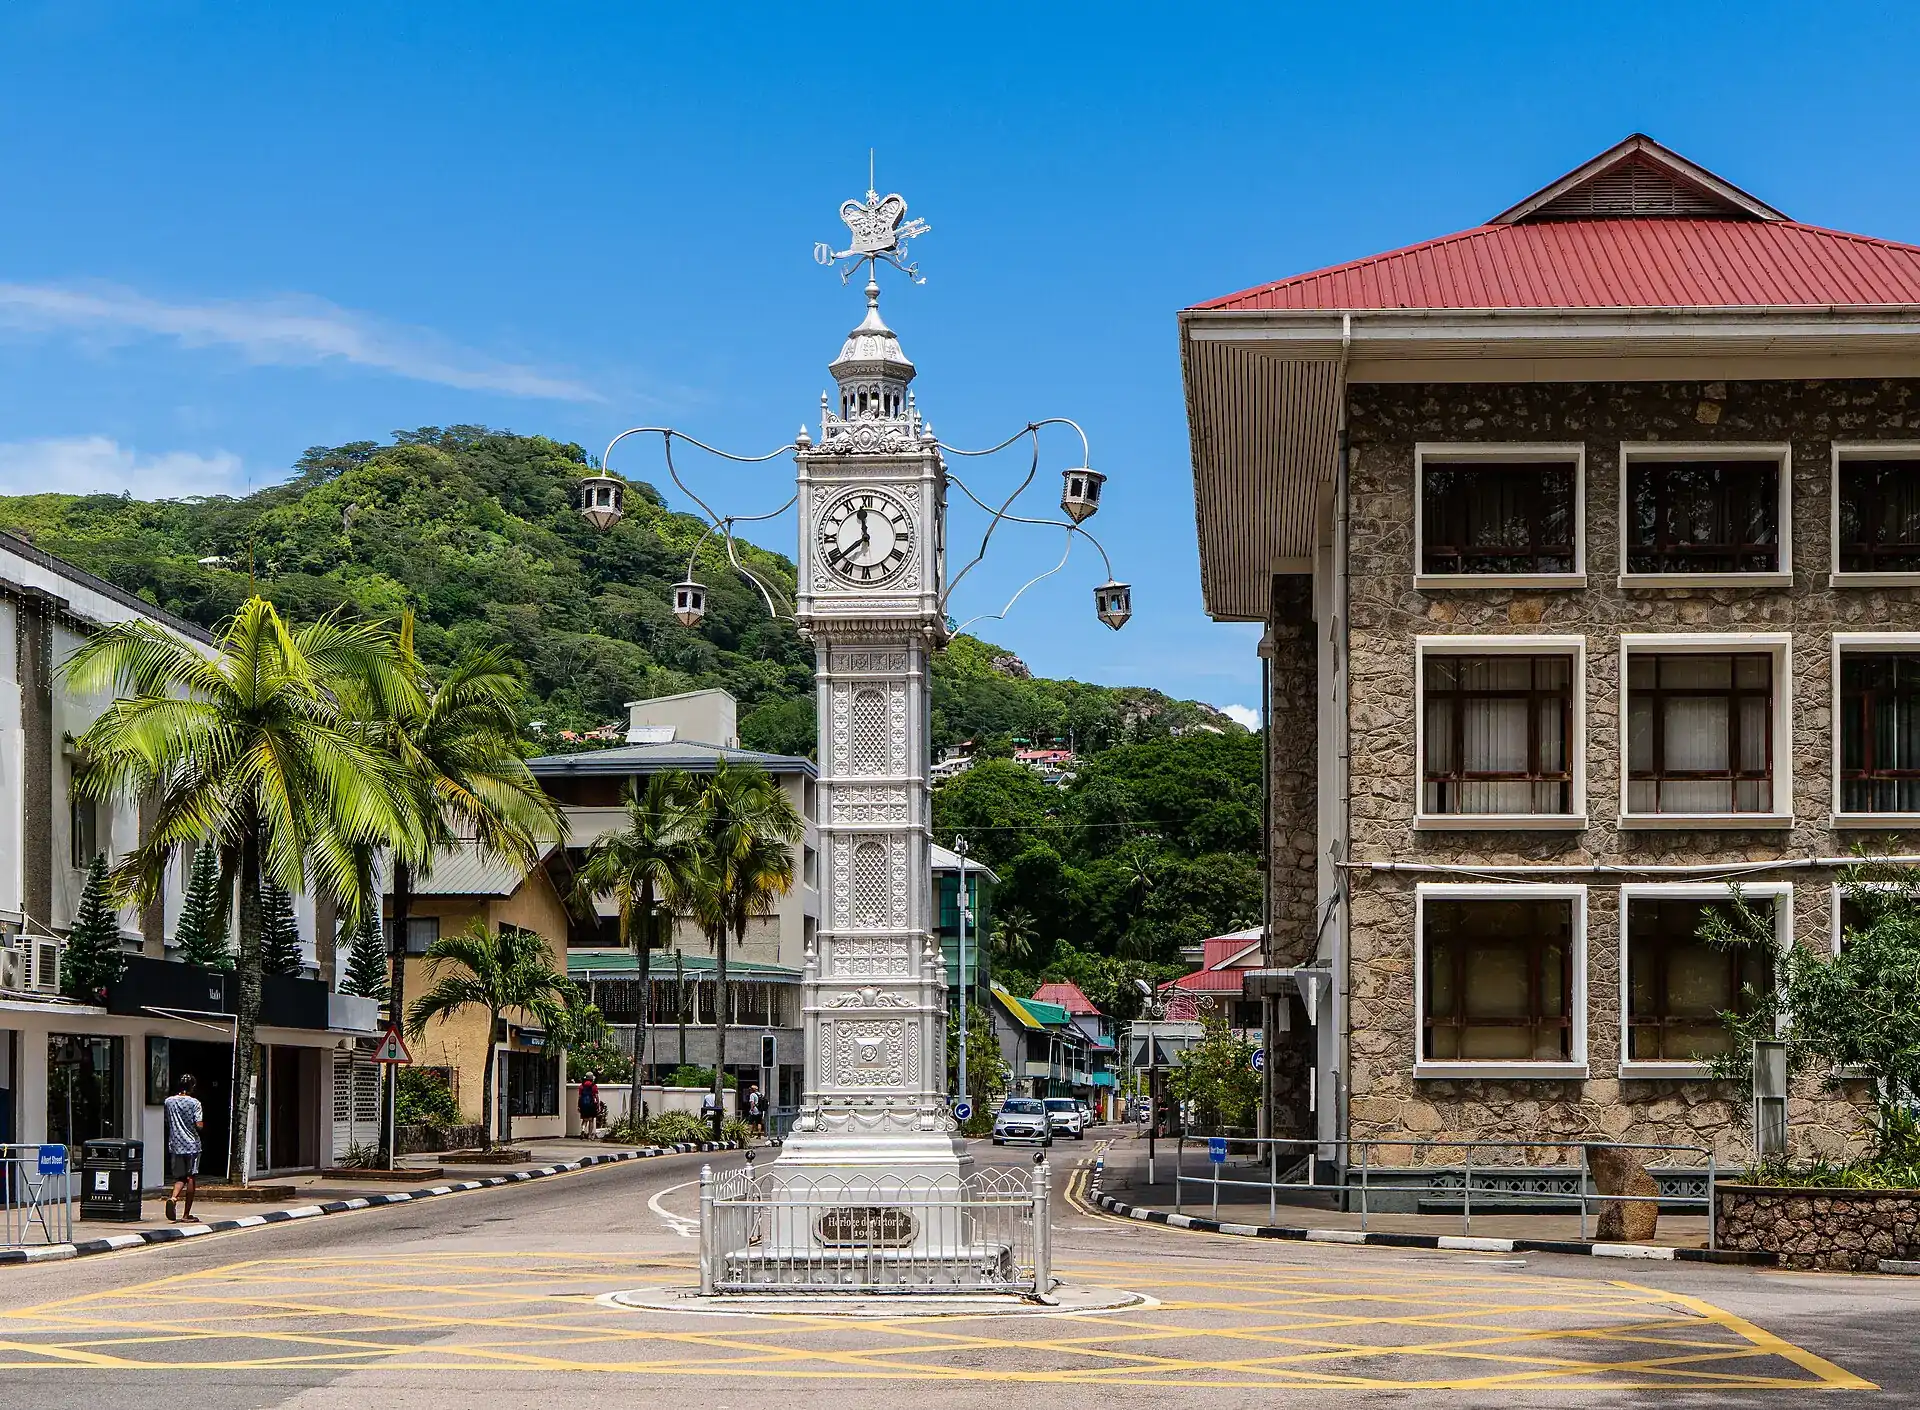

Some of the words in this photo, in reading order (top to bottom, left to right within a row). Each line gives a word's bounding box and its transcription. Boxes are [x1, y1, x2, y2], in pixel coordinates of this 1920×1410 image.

[861, 495, 873, 508] XII
[880, 501, 888, 511] I
[842, 500, 855, 514] XI
[829, 516, 842, 526] X
[891, 514, 904, 524] II
[824, 533, 837, 543] IX
[895, 533, 908, 541] III
[841, 562, 854, 576] VII
[862, 566, 871, 579] VI
[880, 562, 890, 575] V
[41, 1156, 51, 1165] Albert
[52, 1156, 63, 1165] Street
